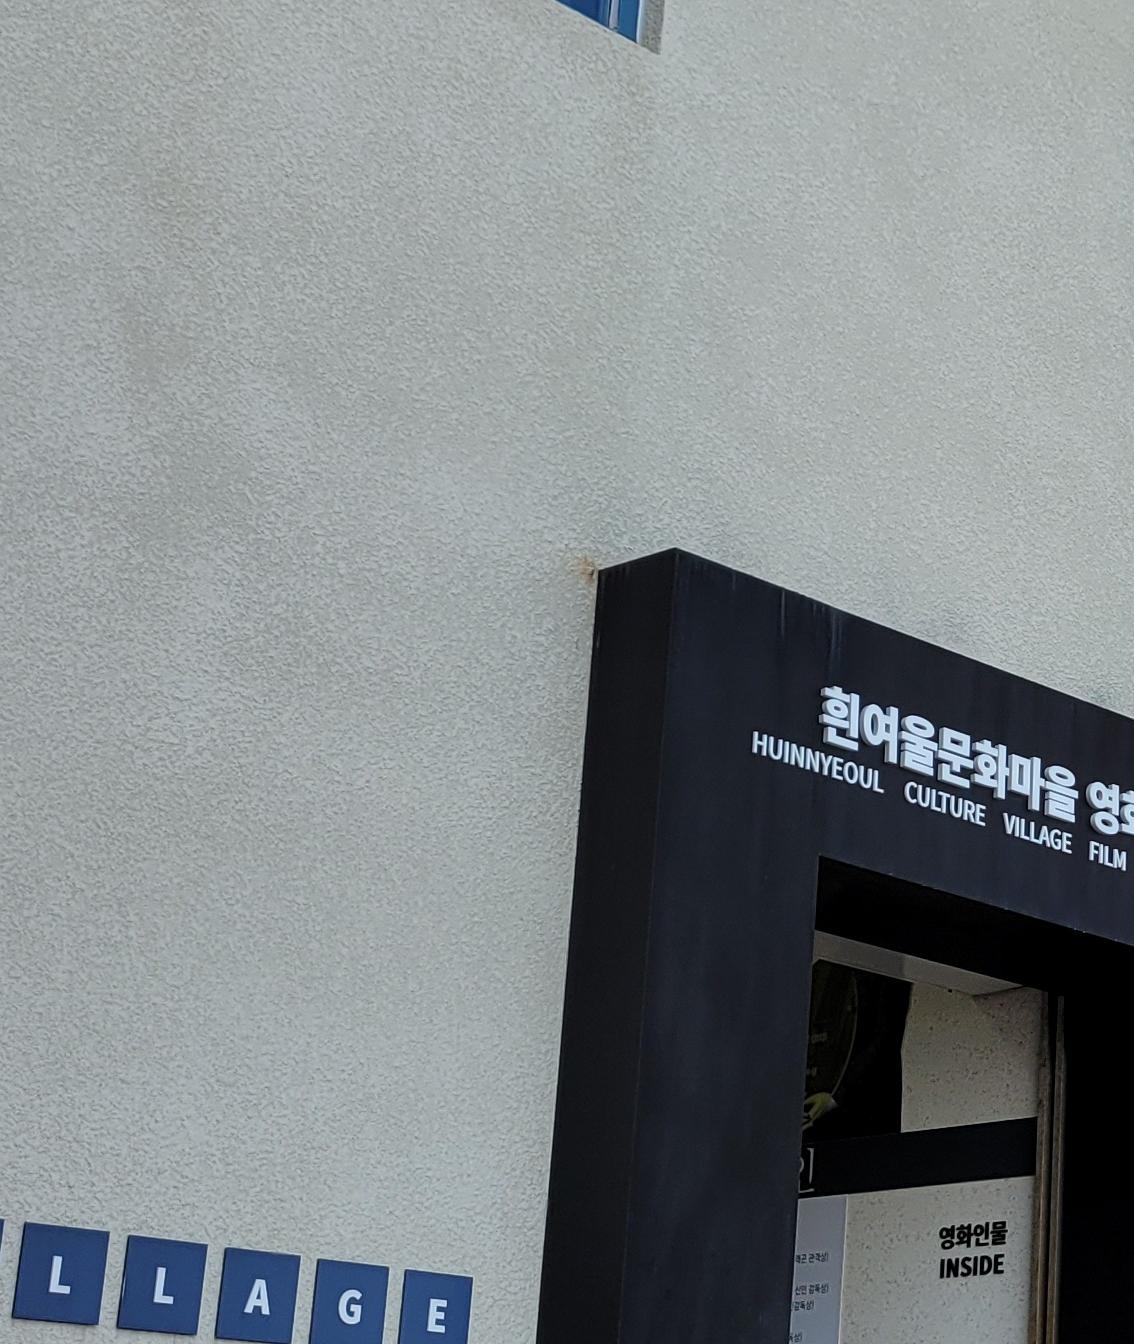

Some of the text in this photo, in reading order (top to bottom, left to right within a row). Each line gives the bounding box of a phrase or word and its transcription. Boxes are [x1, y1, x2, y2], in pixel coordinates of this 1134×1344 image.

[818, 685, 1079, 823] 흰여울문화마을
[752, 731, 884, 794] HUINNYEOUL
[904, 781, 986, 827] CULTURE
[1002, 812, 1073, 854] VILLAGE
[1089, 840, 1127, 871] FILM
[938, 1220, 1008, 1250] 영화인물
[938, 1253, 1005, 1279] INSIDE
